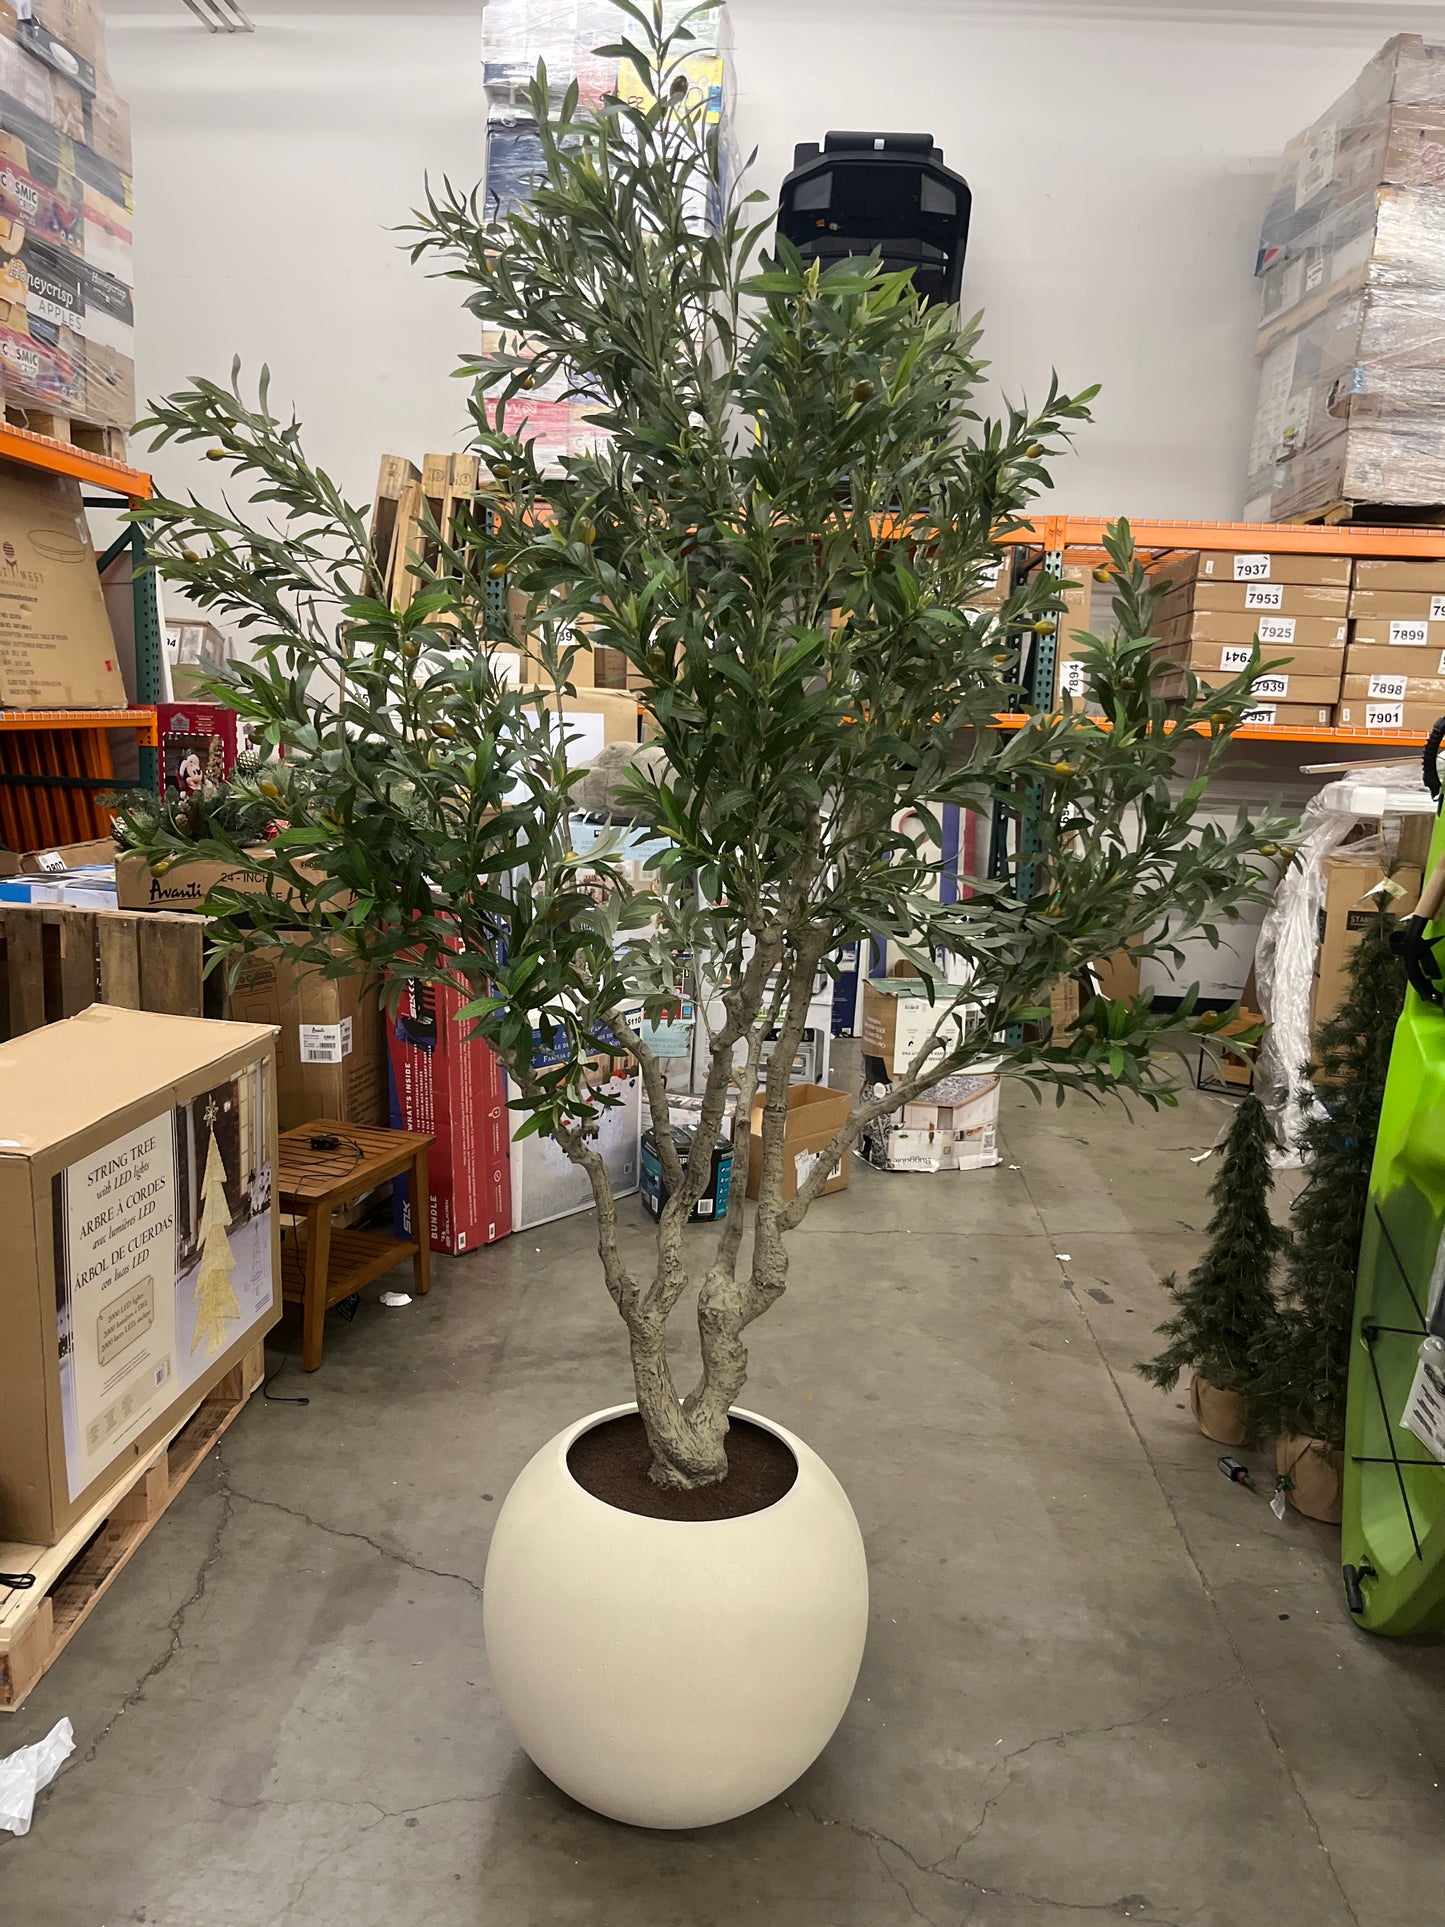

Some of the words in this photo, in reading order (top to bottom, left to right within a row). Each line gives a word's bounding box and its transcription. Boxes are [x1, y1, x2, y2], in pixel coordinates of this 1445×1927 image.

[9, 259, 74, 309] Honeycrisp
[39, 299, 82, 331] APPLES
[1236, 564, 1268, 577] 7937
[1248, 593, 1280, 605] 7953
[1261, 626, 1292, 639] 7925
[1392, 630, 1425, 641] 7899
[1371, 682, 1403, 695] 7898
[1368, 712, 1400, 724] 7901
[149, 878, 203, 903] Avanti
[221, 872, 234, 883] 24
[404, 1062, 412, 1094] INSIDE
[87, 1153, 128, 1187] STRING
[129, 1136, 157, 1161] TREE
[96, 1180, 112, 1200] with
[114, 1170, 132, 1190] LED
[133, 1160, 150, 1181] lights
[80, 1206, 114, 1240] ARBRE
[117, 1198, 124, 1216] À
[126, 1175, 166, 1209] CORDES
[403, 1200, 412, 1235] SLK
[430, 1195, 438, 1240] BUNDLE
[92, 1234, 107, 1250] avec
[108, 1215, 136, 1240] lumières
[138, 1200, 156, 1221] LED
[74, 1257, 109, 1293] ÁRBOL
[111, 1248, 126, 1266] DE
[127, 1214, 174, 1255] CUERDAS
[101, 1277, 112, 1291] con
[114, 1263, 130, 1283] luces
[132, 1248, 150, 1271] LED
